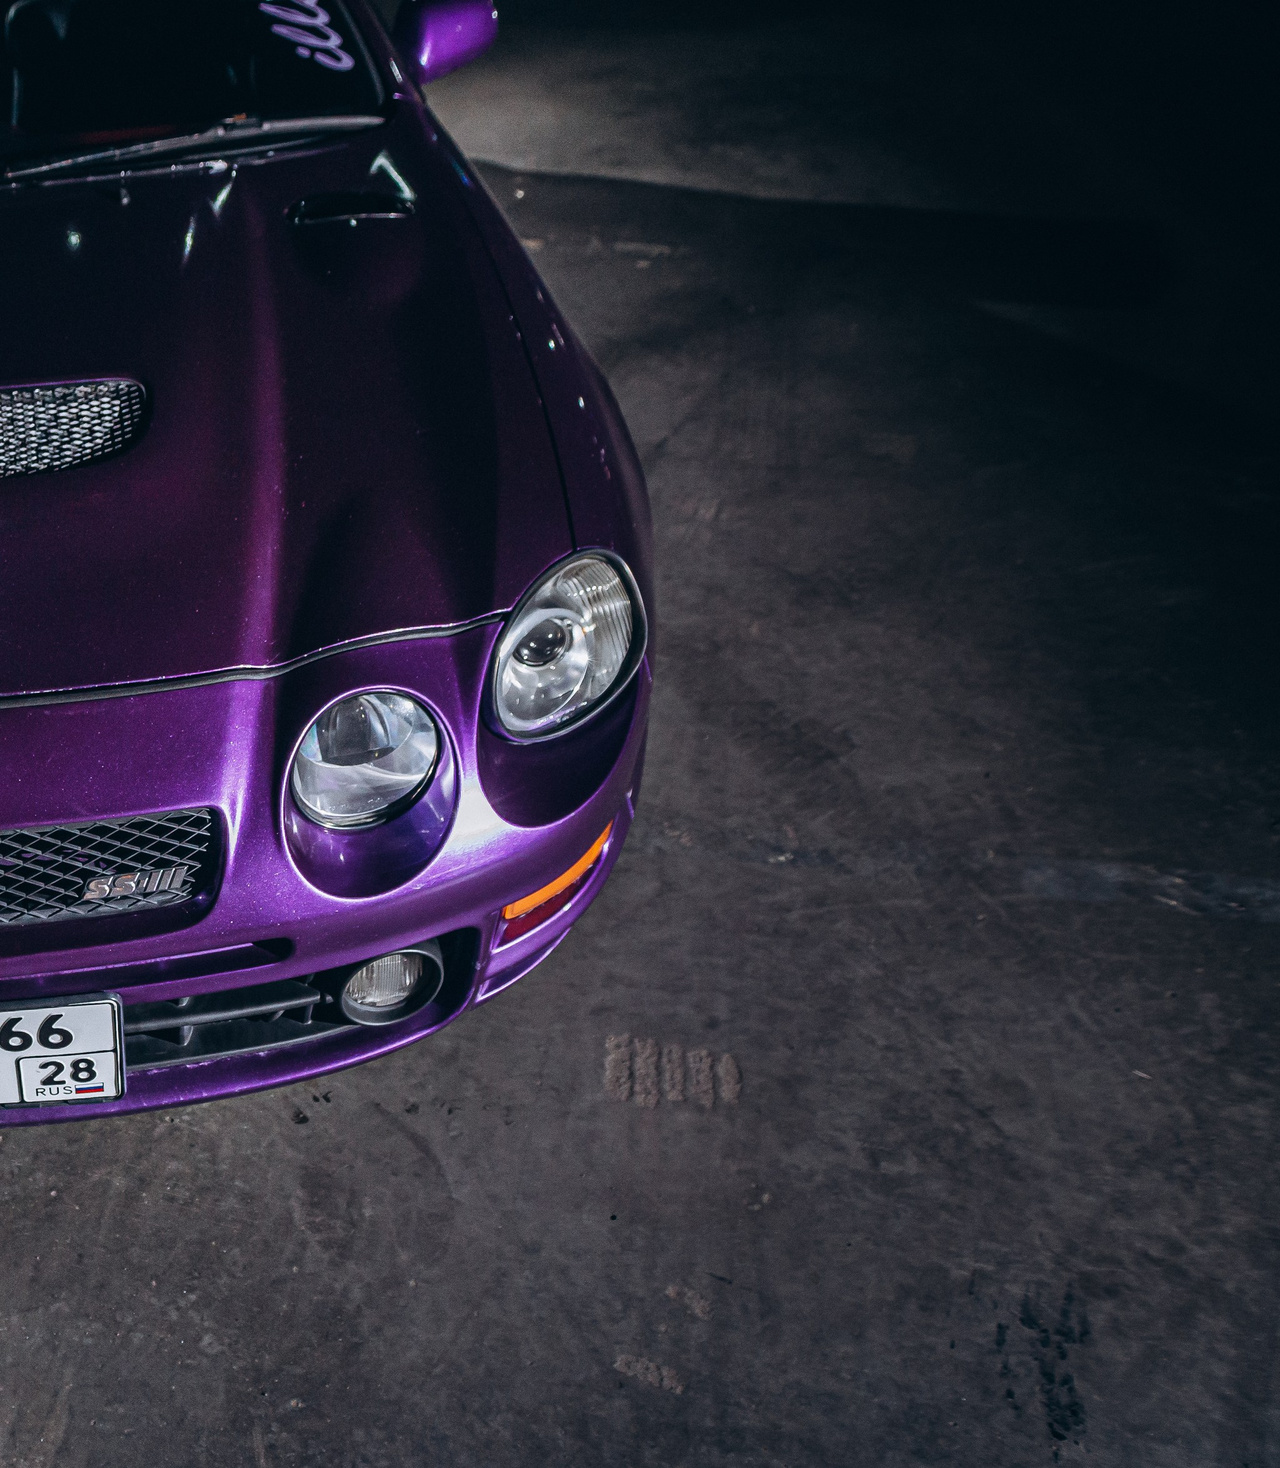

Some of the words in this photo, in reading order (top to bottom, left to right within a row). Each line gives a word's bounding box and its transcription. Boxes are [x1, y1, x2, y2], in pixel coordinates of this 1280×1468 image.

[258, 0, 355, 72] ill
[37, 1057, 98, 1086] 28
[35, 1085, 74, 1097] RUS
